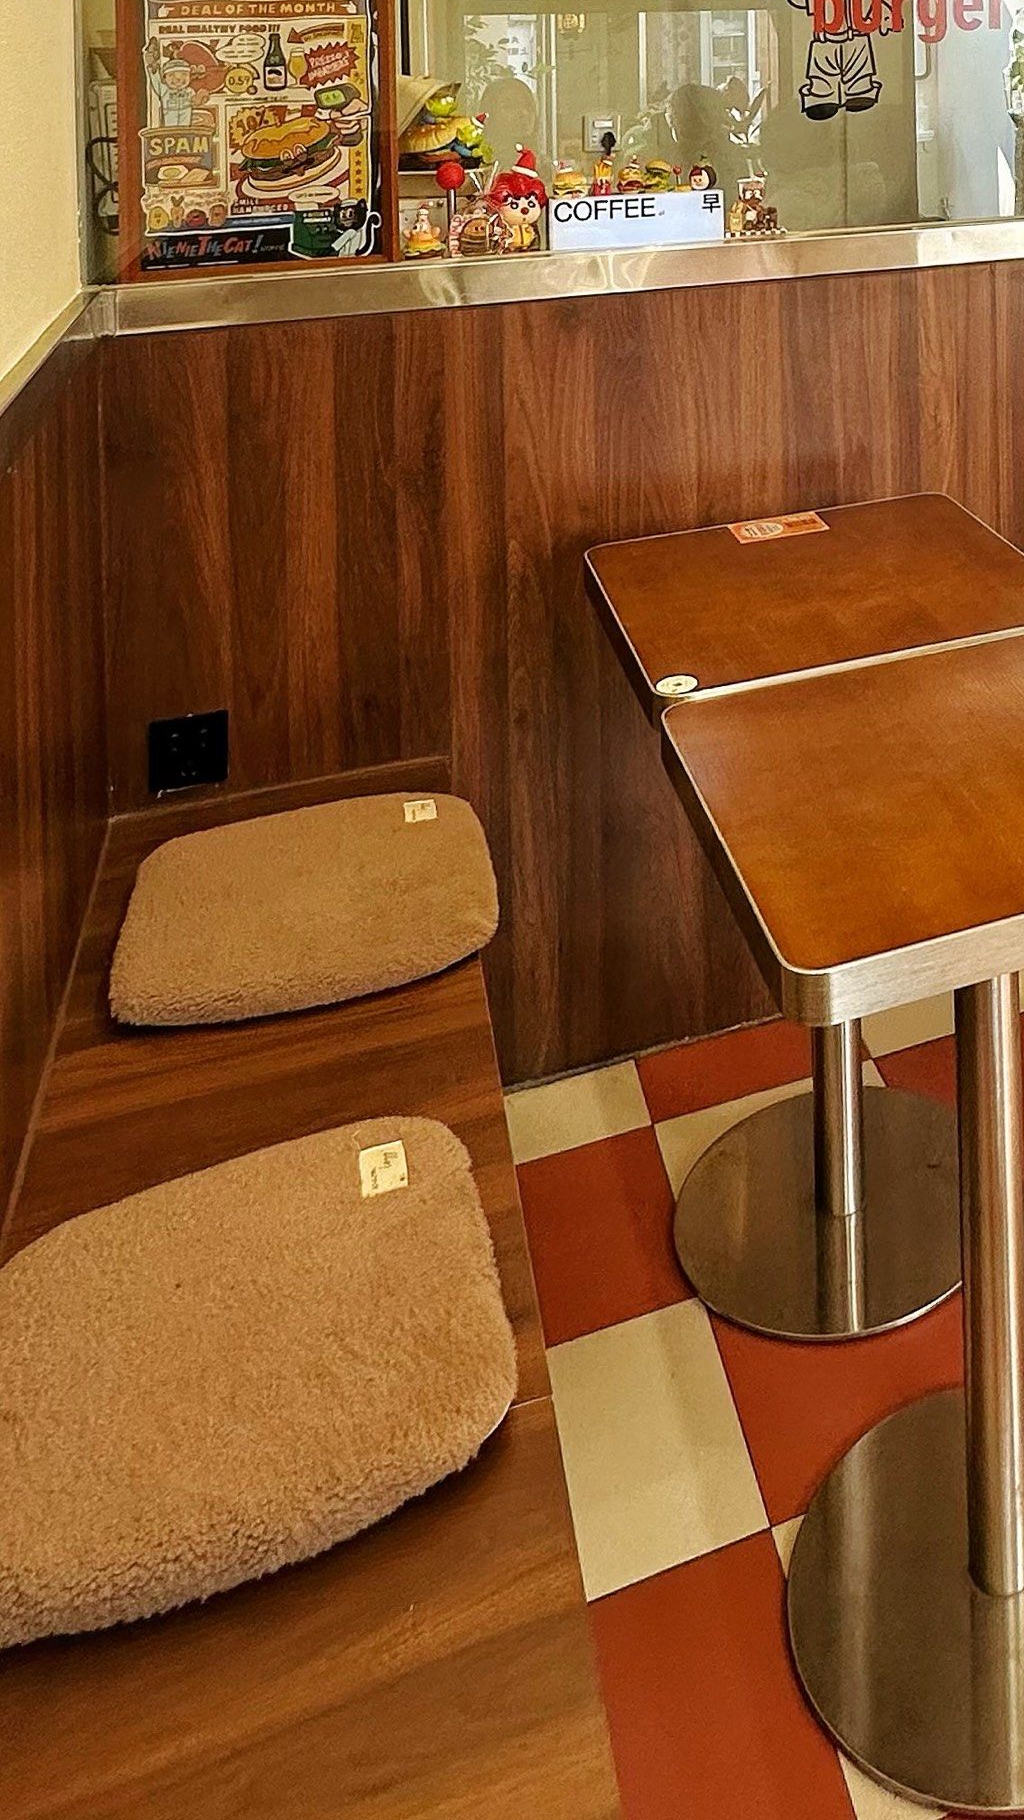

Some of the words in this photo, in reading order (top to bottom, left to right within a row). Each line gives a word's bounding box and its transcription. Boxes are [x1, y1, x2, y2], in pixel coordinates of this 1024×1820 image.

[180, 4, 222, 16] DEAL
[226, 3, 245, 15] OF
[248, 3, 276, 15] THE
[280, 2, 336, 14] MONTH
[148, 136, 210, 157] SPAM
[554, 197, 656, 223] COFFEE
[702, 193, 721, 214] 早
